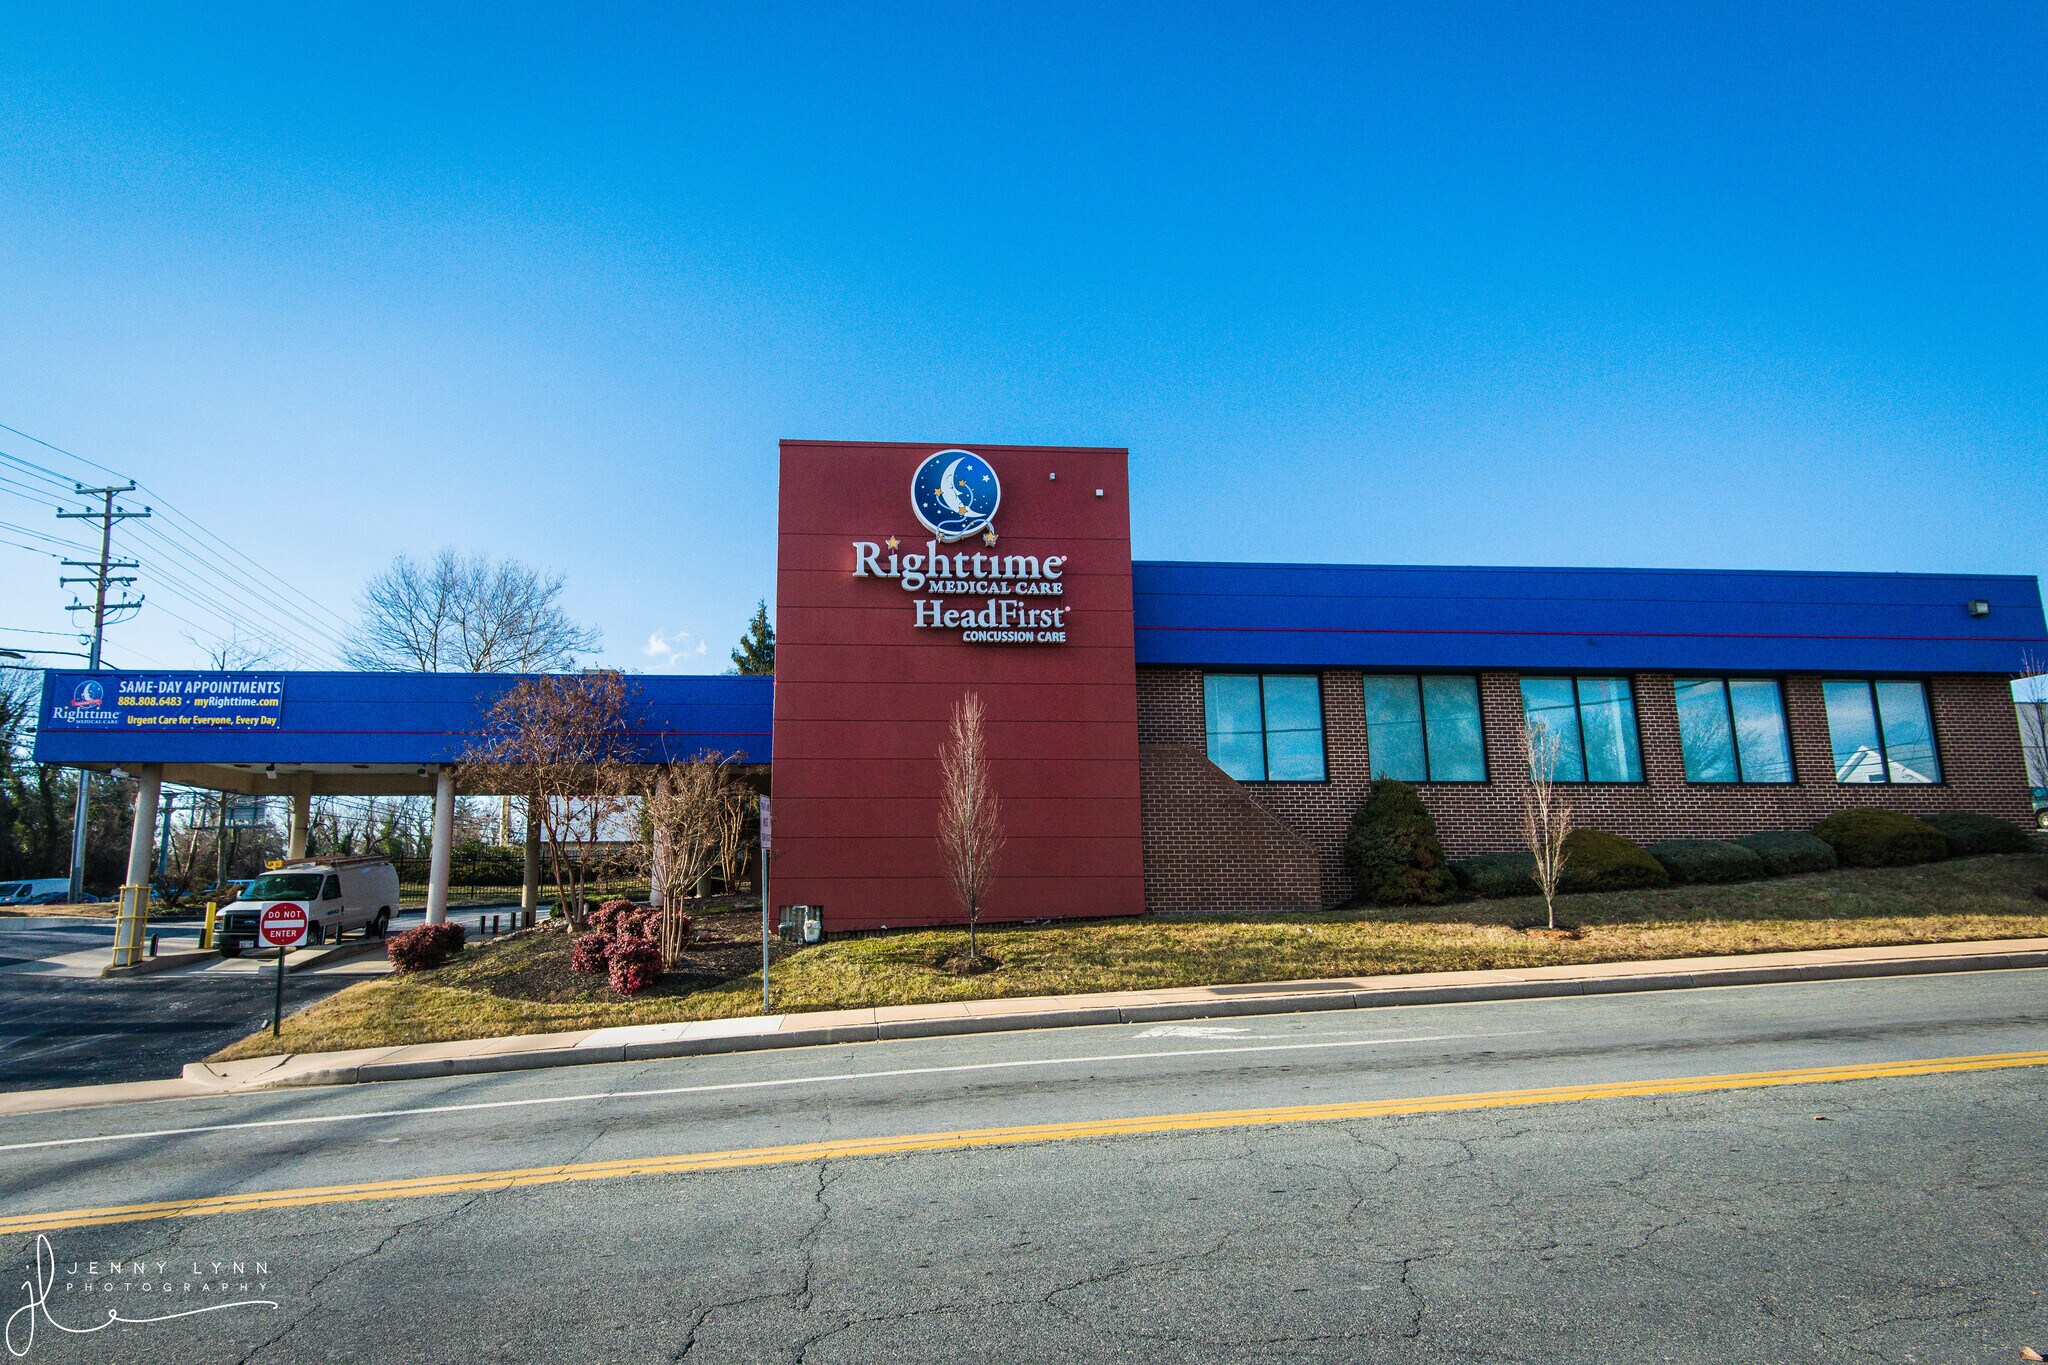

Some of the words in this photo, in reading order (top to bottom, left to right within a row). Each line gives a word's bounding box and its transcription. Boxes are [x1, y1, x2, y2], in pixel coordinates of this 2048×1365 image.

[928, 580, 1011, 594] MEDICAL
[1015, 582, 1063, 595] CARE
[962, 631, 1034, 643] CONCUSSION
[1037, 632, 1066, 643] CARE
[119, 681, 182, 694] SAME-DAY
[184, 681, 281, 694] APPOINTMENTS
[118, 696, 182, 706] 888.808.6483
[194, 696, 279, 708] myRighttime.com
[52, 706, 119, 723] Righttime
[127, 715, 157, 726] Urgent
[158, 715, 177, 724] Care
[178, 715, 192, 724] for
[193, 715, 234, 726] Everyone,
[235, 715, 259, 726] Every
[260, 715, 277, 726] Day
[270, 930, 297, 938] ENTER
